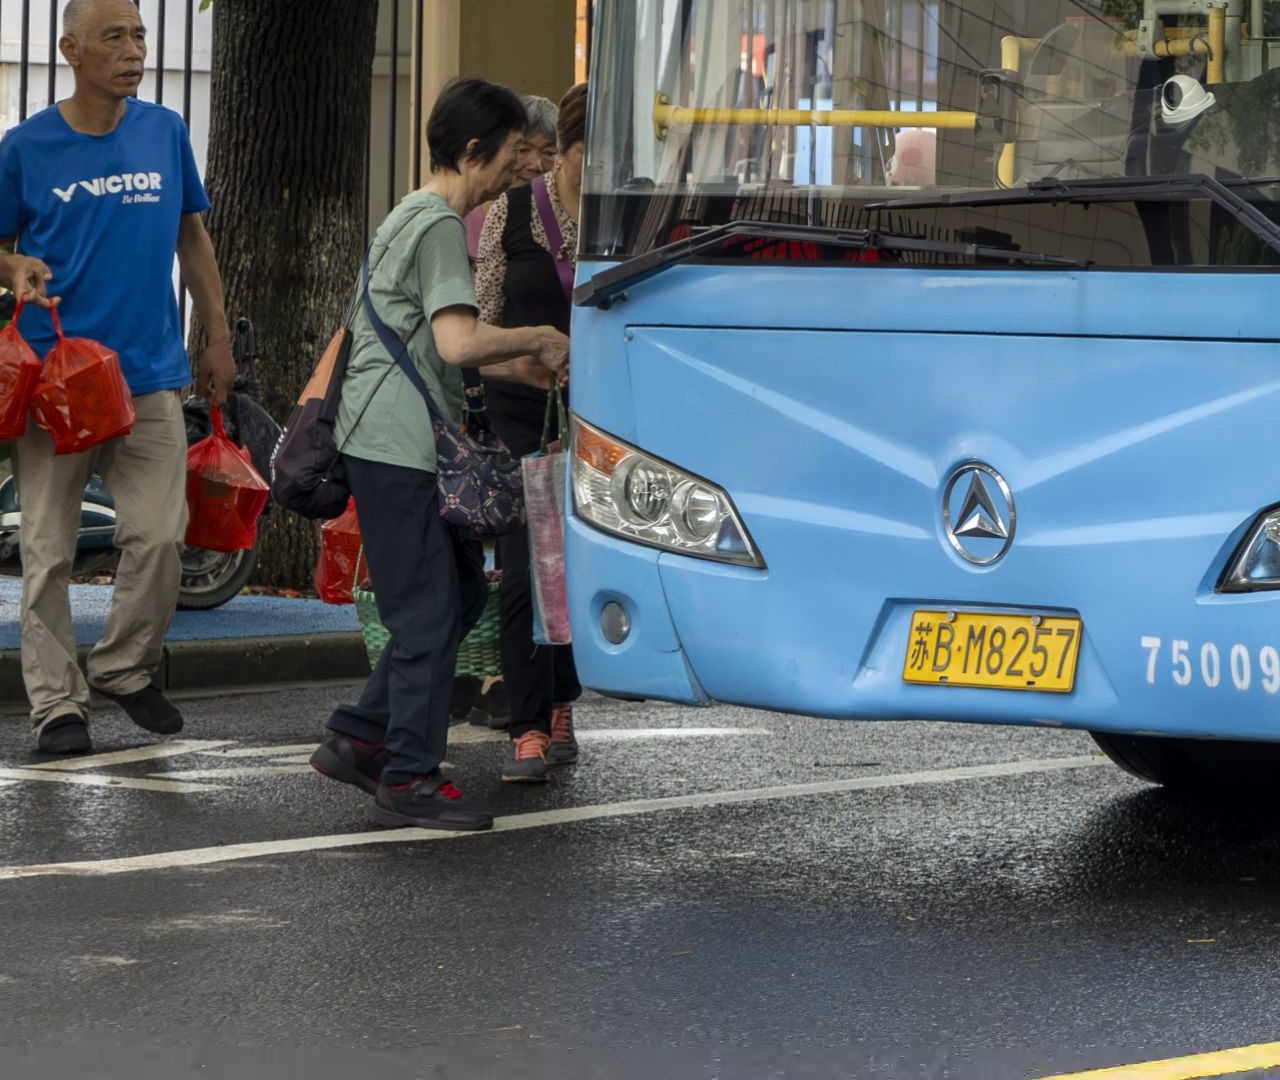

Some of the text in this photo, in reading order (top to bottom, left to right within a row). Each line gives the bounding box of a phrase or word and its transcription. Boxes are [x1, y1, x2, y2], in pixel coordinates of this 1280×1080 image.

[80, 172, 162, 196] VICTOR
[910, 622, 1075, 679] 苏B·M8257
[1141, 636, 1280, 693] 75009
